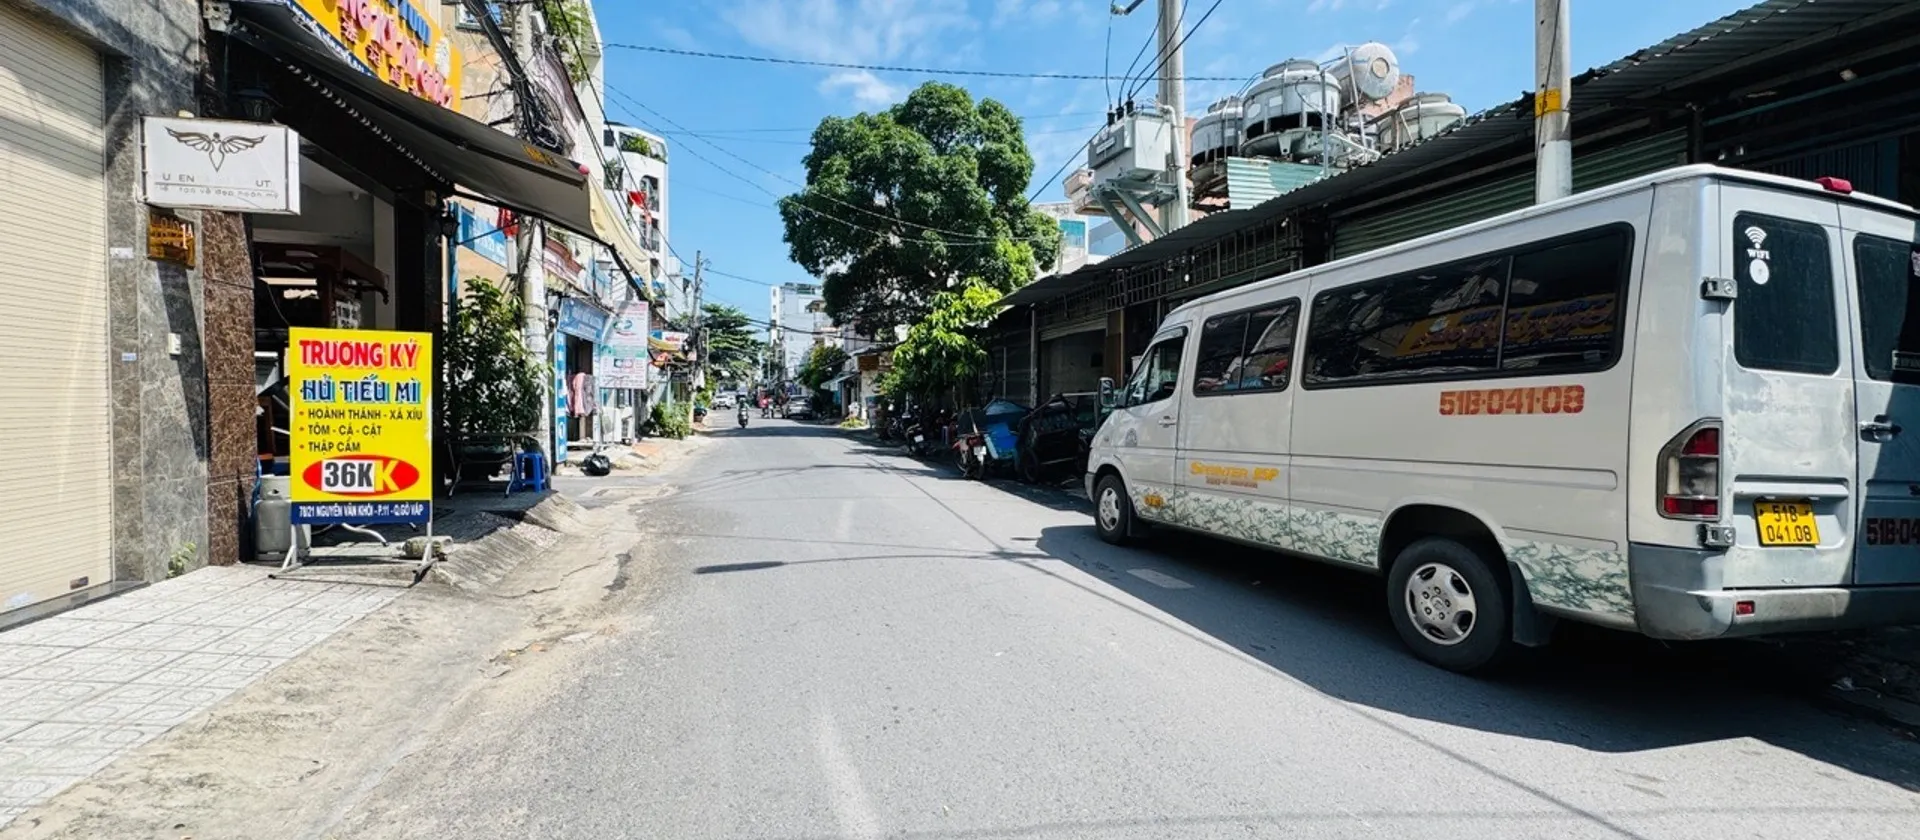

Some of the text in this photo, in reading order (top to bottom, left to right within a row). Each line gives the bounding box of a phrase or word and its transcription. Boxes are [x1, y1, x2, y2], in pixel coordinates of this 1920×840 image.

[299, 339, 384, 368] TRƯƠNG
[300, 373, 421, 404] HỦ TIẾU MÌ
[308, 406, 345, 420] HOÀNH
[348, 406, 381, 420] THÁNH
[389, 406, 403, 420] XÁ
[406, 407, 423, 420] XÍU
[308, 422, 330, 435] TÔM
[338, 423, 353, 435] CÁ
[324, 462, 373, 488] 36K
[1772, 505, 1799, 523] 51B
[1765, 525, 1813, 543] 041.08
